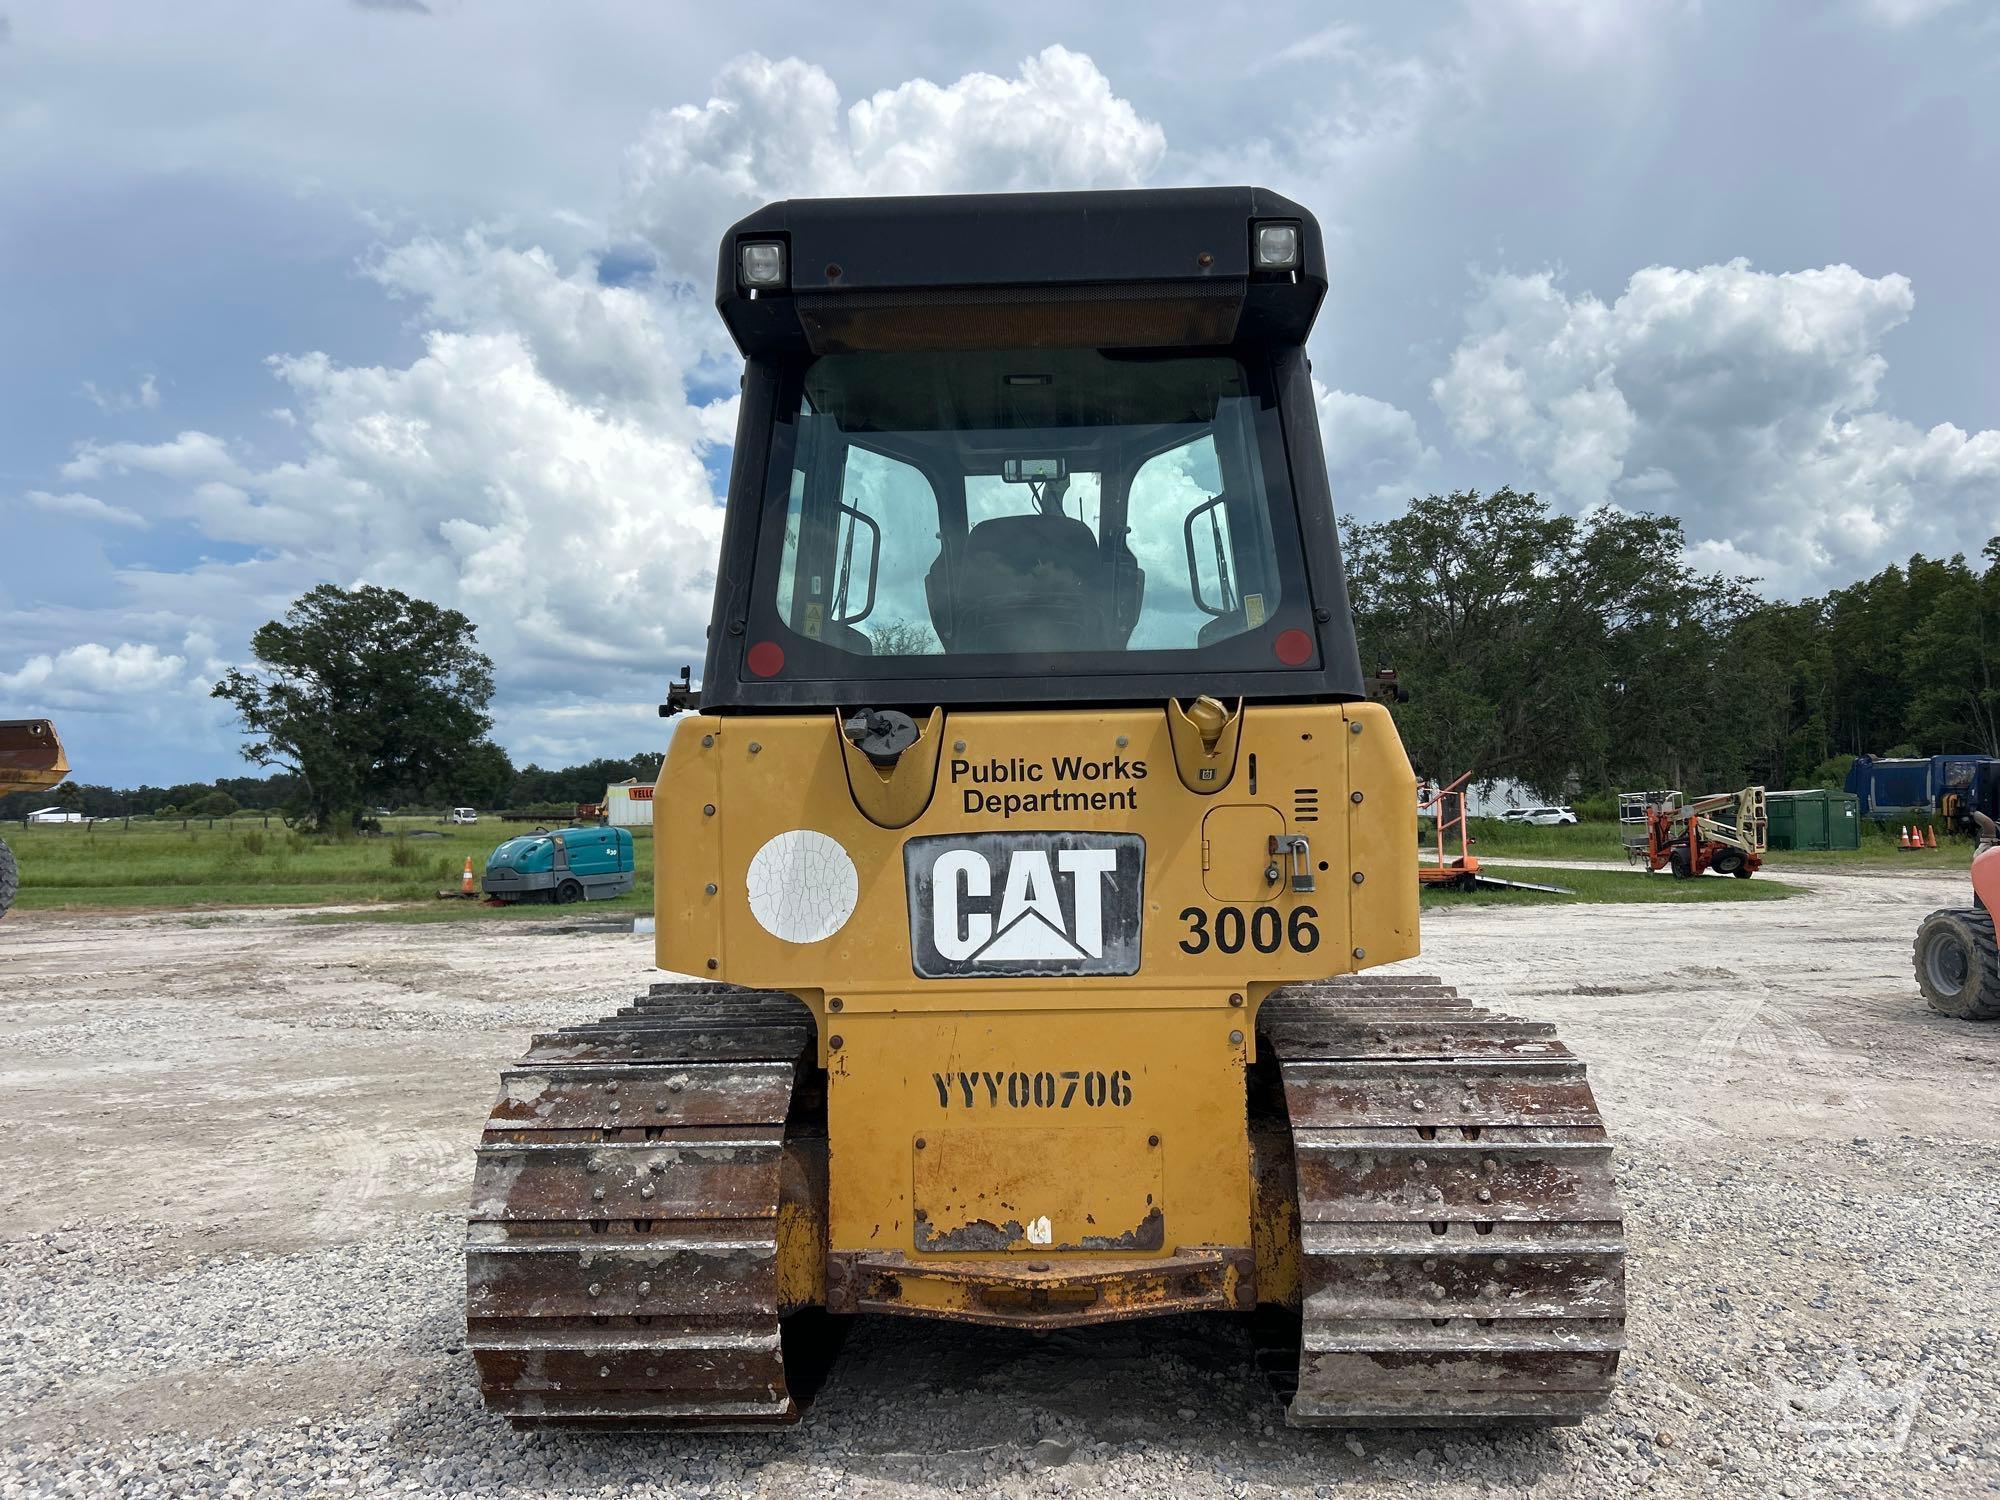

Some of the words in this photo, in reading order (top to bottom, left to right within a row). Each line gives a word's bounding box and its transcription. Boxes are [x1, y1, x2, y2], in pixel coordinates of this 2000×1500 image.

[951, 759, 1042, 784] Public
[1051, 756, 1148, 780] Works
[964, 787, 1137, 819] Department
[932, 849, 1117, 961] CAT
[1179, 906, 1320, 954] 3006
[932, 1070, 1132, 1109] YYY00706
